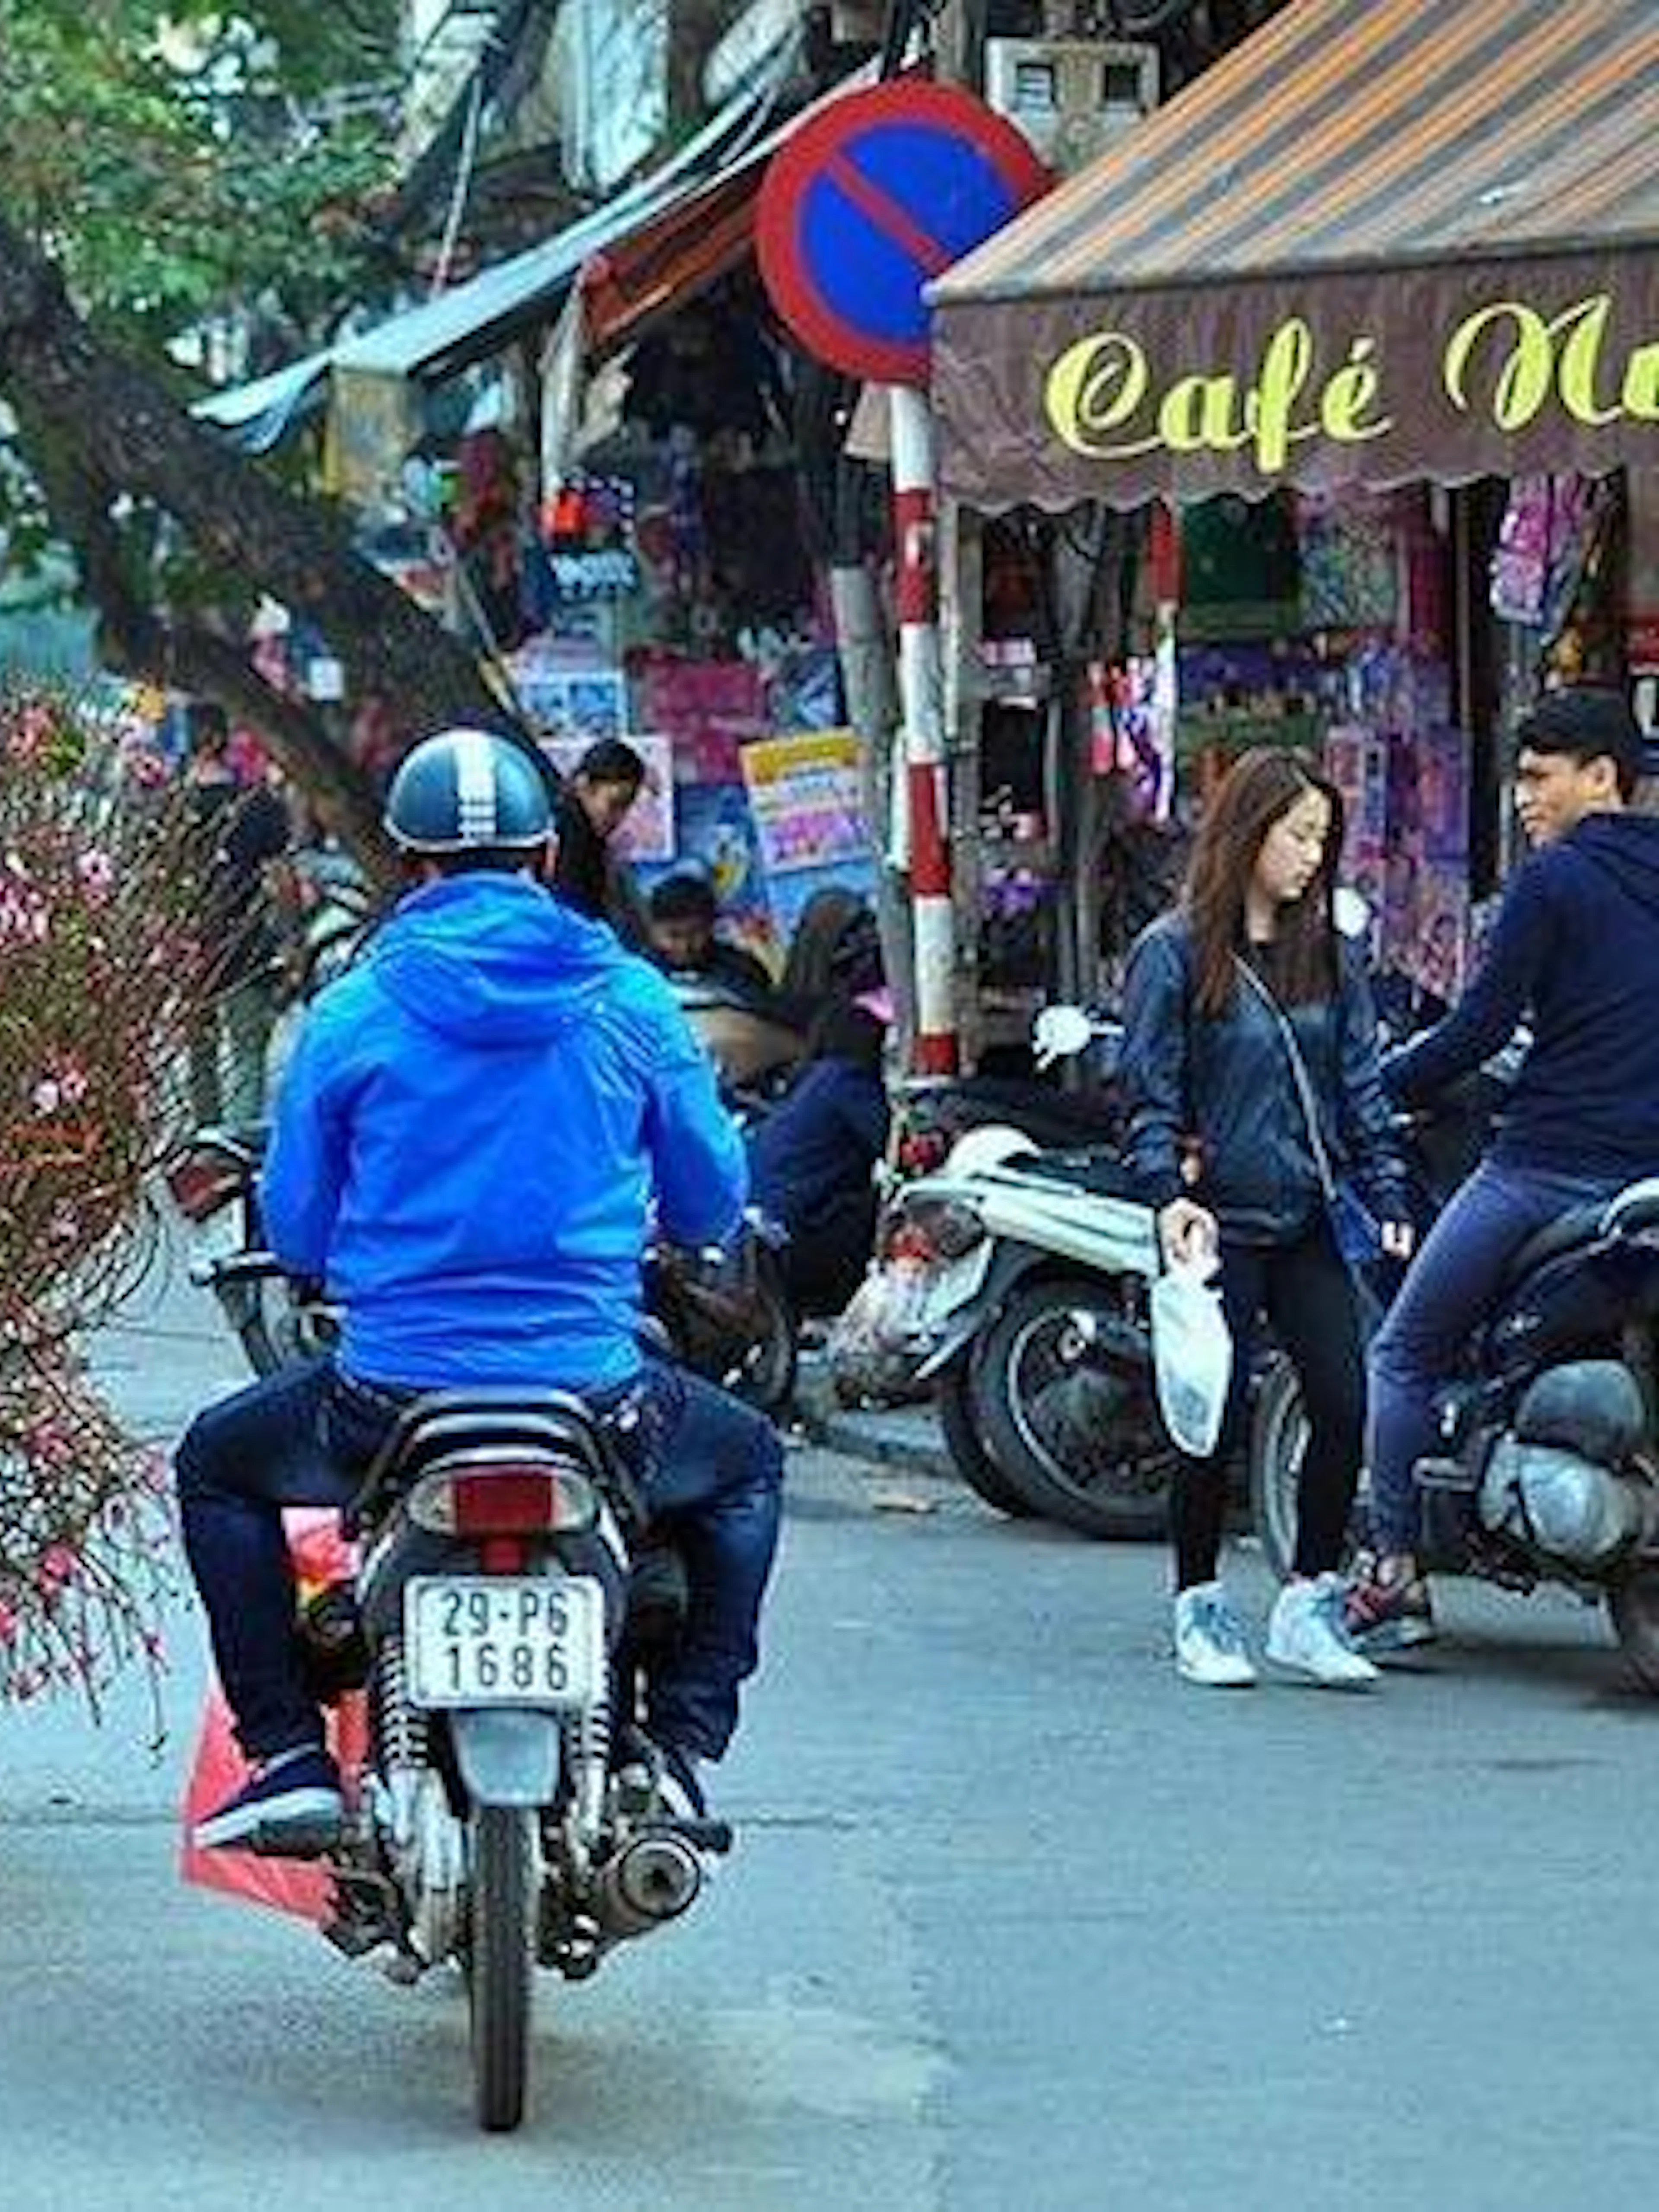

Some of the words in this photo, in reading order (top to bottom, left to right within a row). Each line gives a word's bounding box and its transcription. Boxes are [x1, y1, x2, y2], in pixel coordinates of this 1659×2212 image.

[1045, 318, 1393, 474] Café
[444, 1592, 567, 1636] 29-P6
[448, 1644, 567, 1690] 1686
